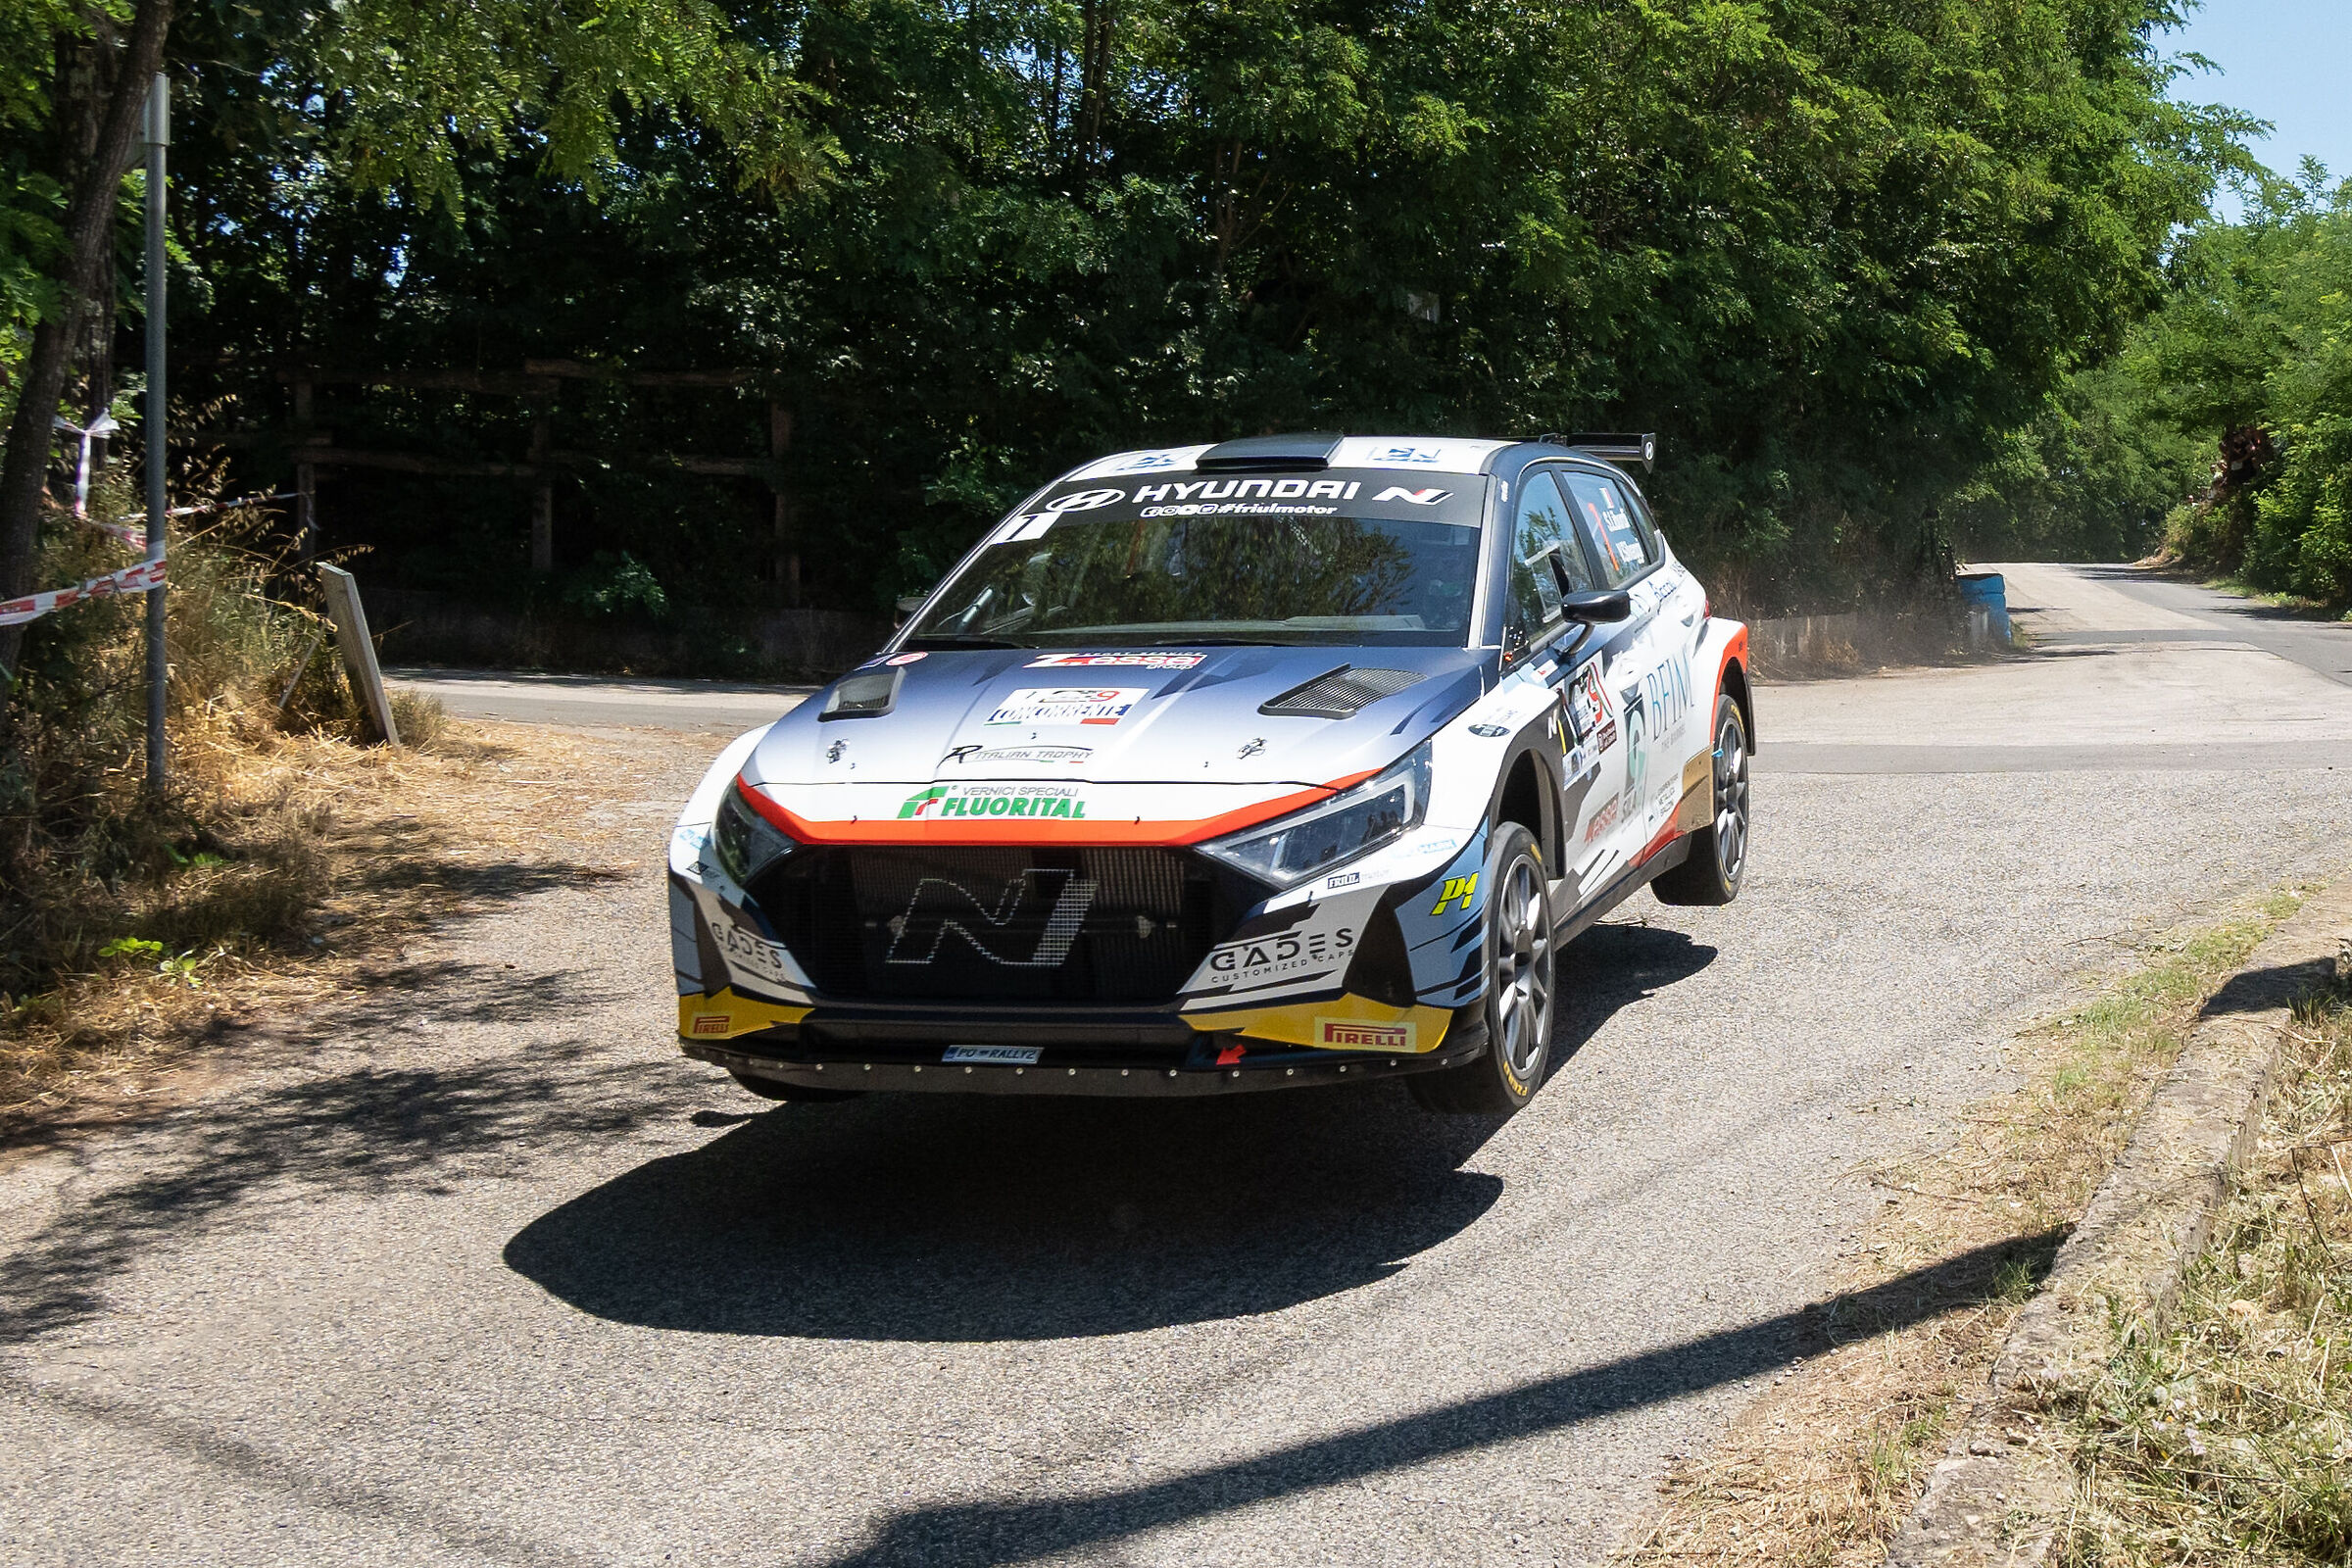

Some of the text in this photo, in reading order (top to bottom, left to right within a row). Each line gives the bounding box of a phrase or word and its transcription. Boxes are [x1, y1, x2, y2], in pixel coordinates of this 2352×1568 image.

[1132, 478, 1362, 503] HYUNDAI
[1215, 502, 1339, 515] #friulmotor
[976, 751, 1031, 760] ITALIAN
[1035, 751, 1095, 760] TROPHY
[963, 787, 1079, 798] VERNICI SPECIALI
[940, 797, 1087, 819] FLUORITAL
[1210, 927, 1353, 972] GADES
[1211, 949, 1354, 984] CUSTOMIZED CAPS
[693, 1015, 730, 1034] PIRELLI
[1324, 1022, 1407, 1047] PIRELLI
